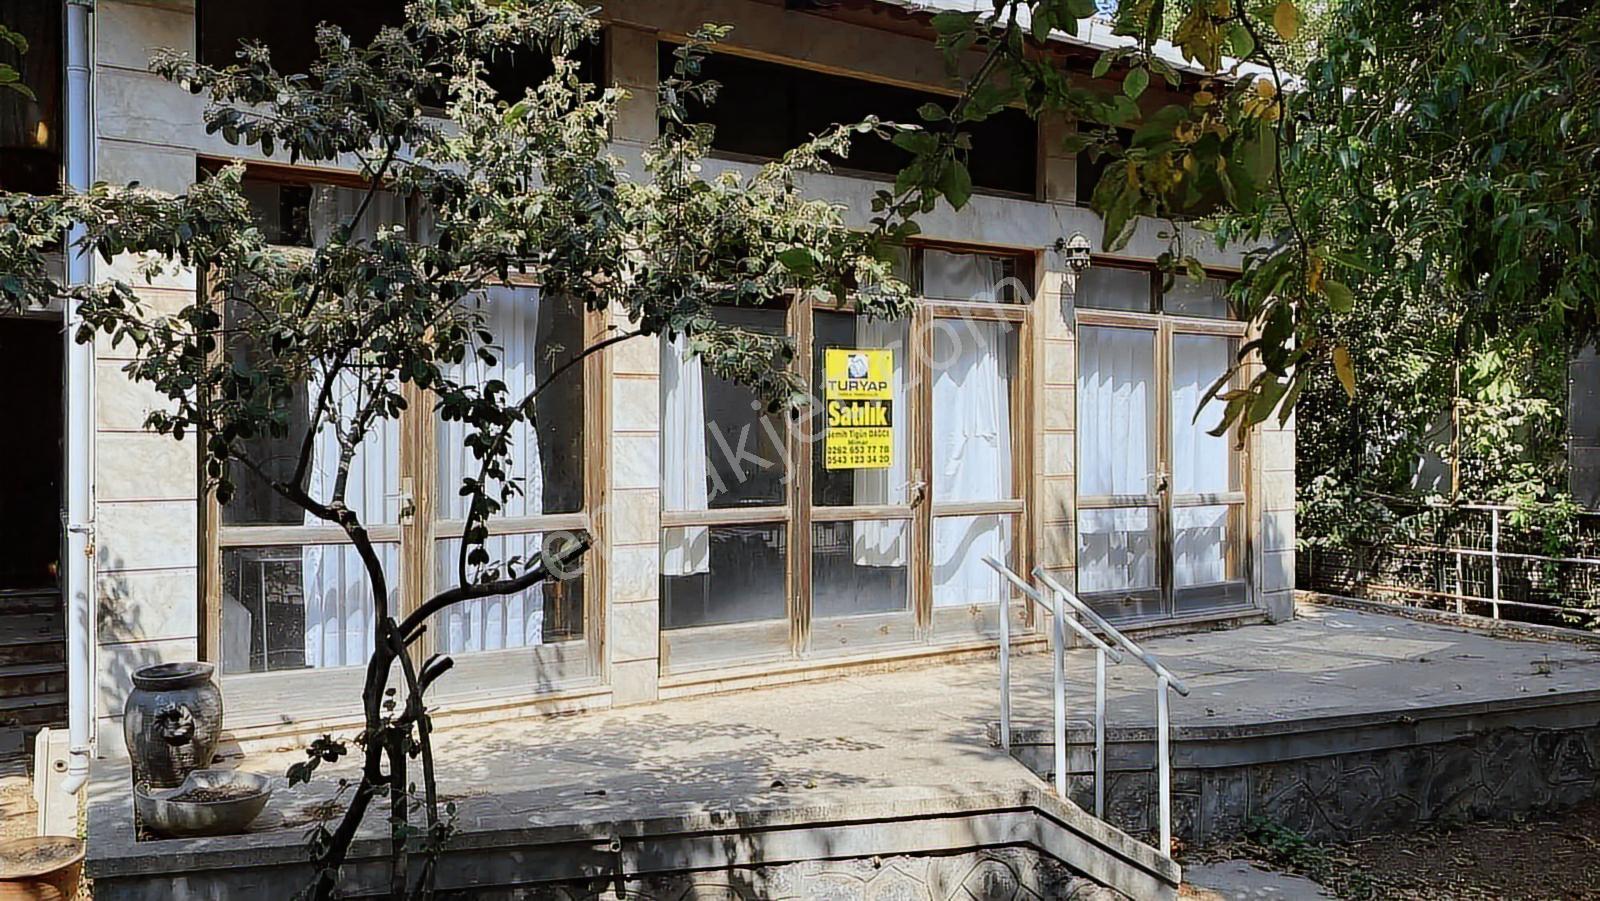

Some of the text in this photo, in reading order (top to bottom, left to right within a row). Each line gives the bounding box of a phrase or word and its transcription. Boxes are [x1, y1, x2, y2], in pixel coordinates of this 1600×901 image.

[828, 380, 888, 392] TURYAP
[829, 400, 888, 427] Satılık
[879, 455, 889, 463] 20
